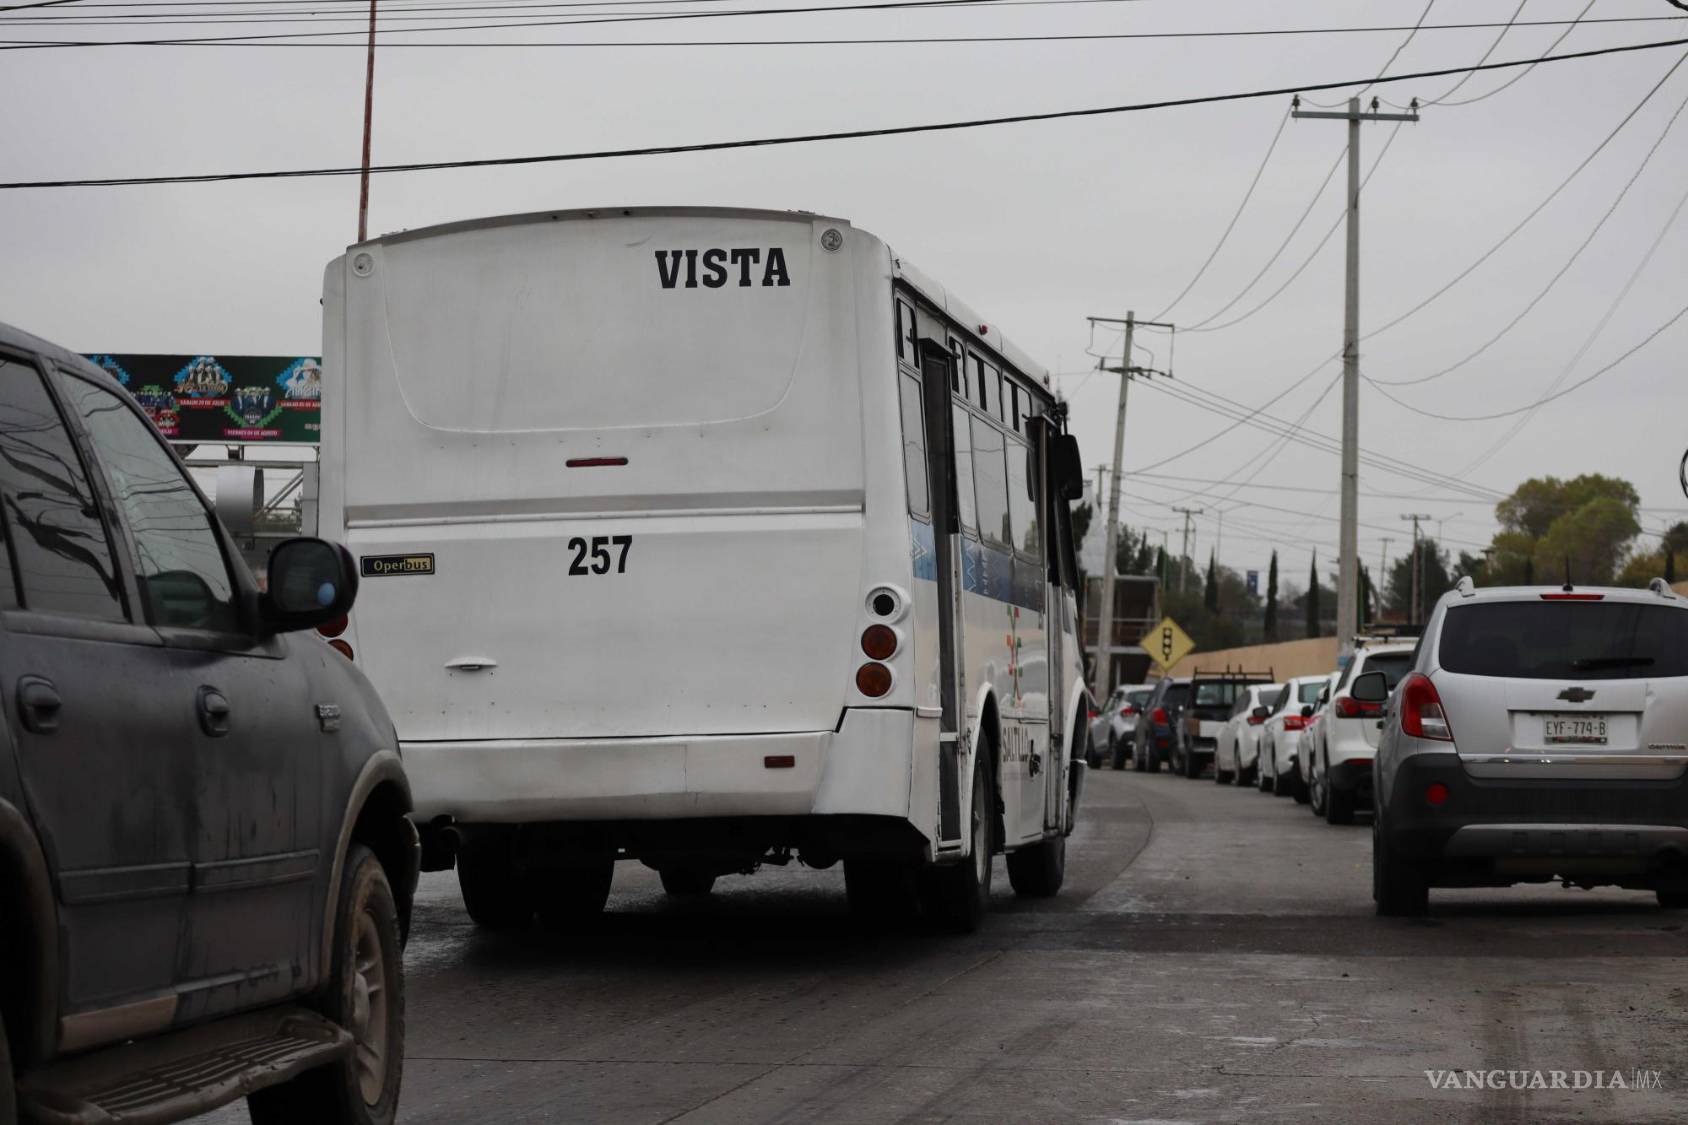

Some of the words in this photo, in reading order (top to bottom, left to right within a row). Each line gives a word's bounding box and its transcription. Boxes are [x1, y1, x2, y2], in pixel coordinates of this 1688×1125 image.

[655, 248, 791, 288] VISTA
[373, 558, 430, 573] Operbus
[567, 535, 633, 576] 257
[1546, 721, 1606, 735] EYF-774-B
